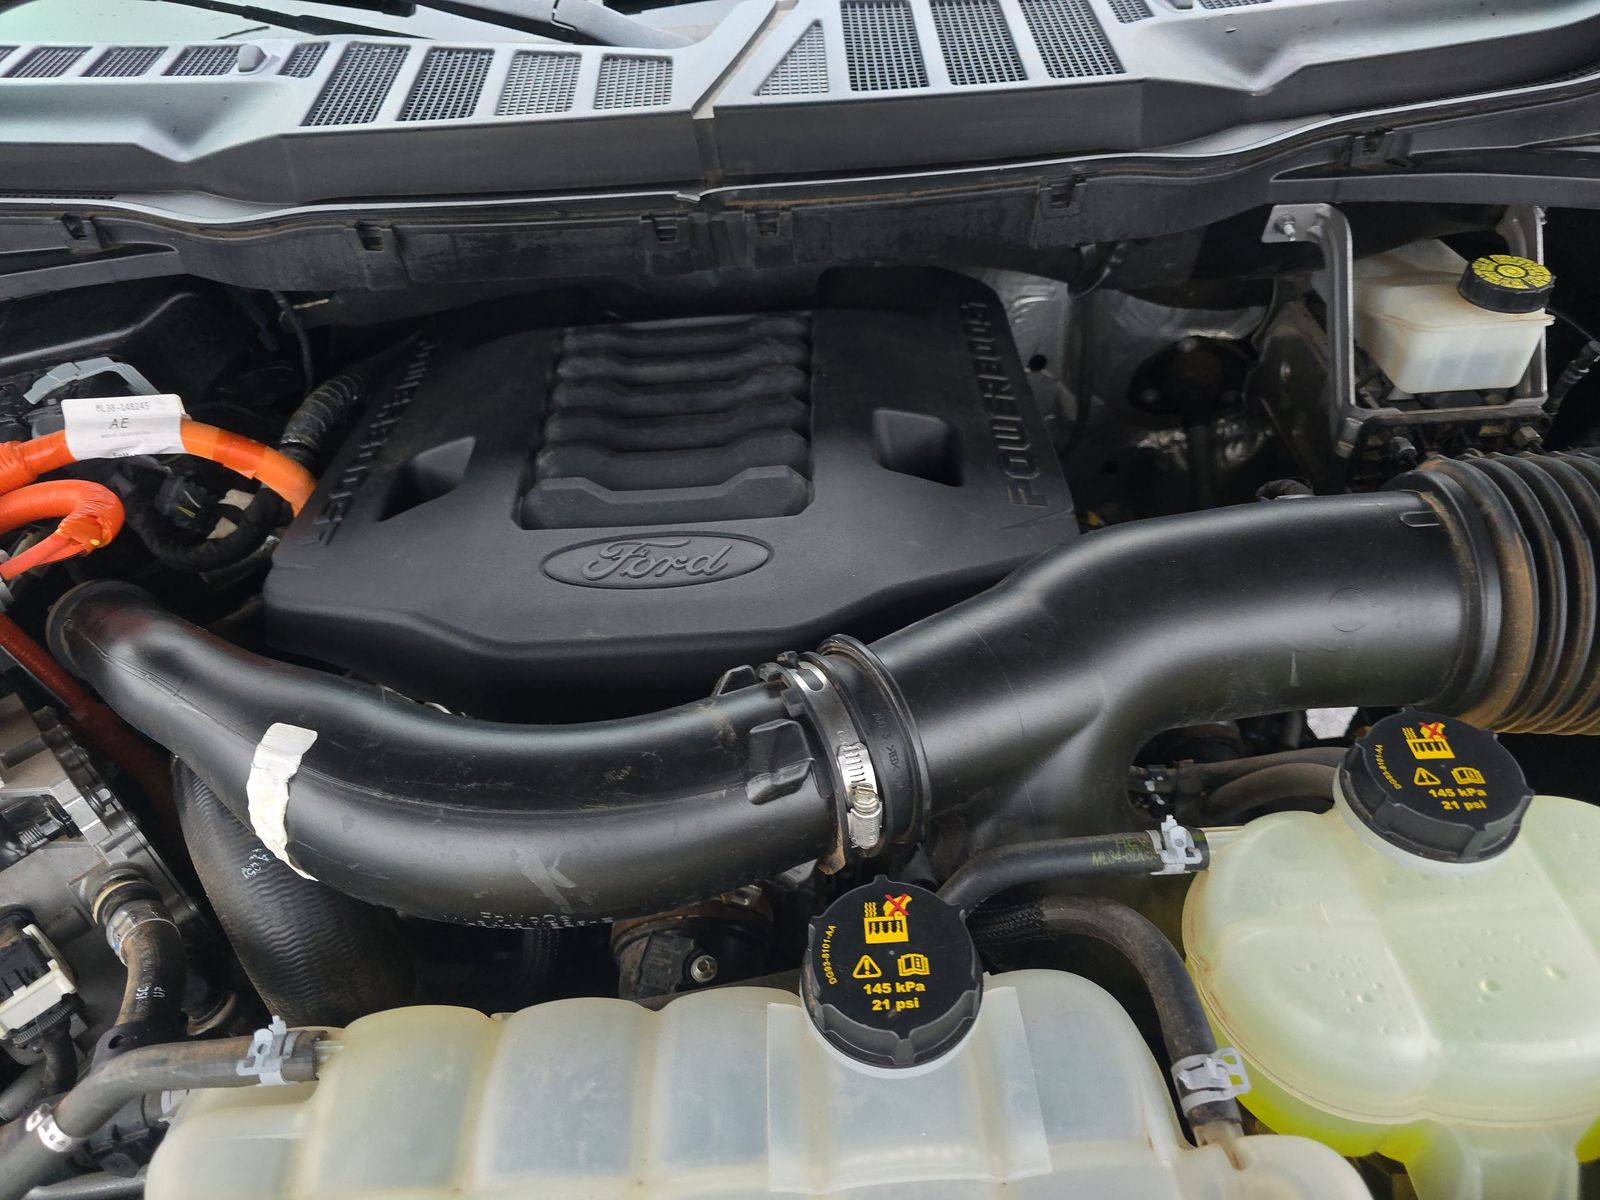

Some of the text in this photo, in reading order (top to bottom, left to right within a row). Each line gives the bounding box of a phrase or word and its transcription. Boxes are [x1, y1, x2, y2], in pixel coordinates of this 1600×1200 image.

[109, 417, 129, 430] AE
[582, 539, 734, 582] Ford
[1428, 788, 1487, 798] 145 kPa
[1441, 800, 1487, 811] 21 psi
[863, 981, 926, 995] 145 kPa
[871, 997, 920, 1012] 21 psi
